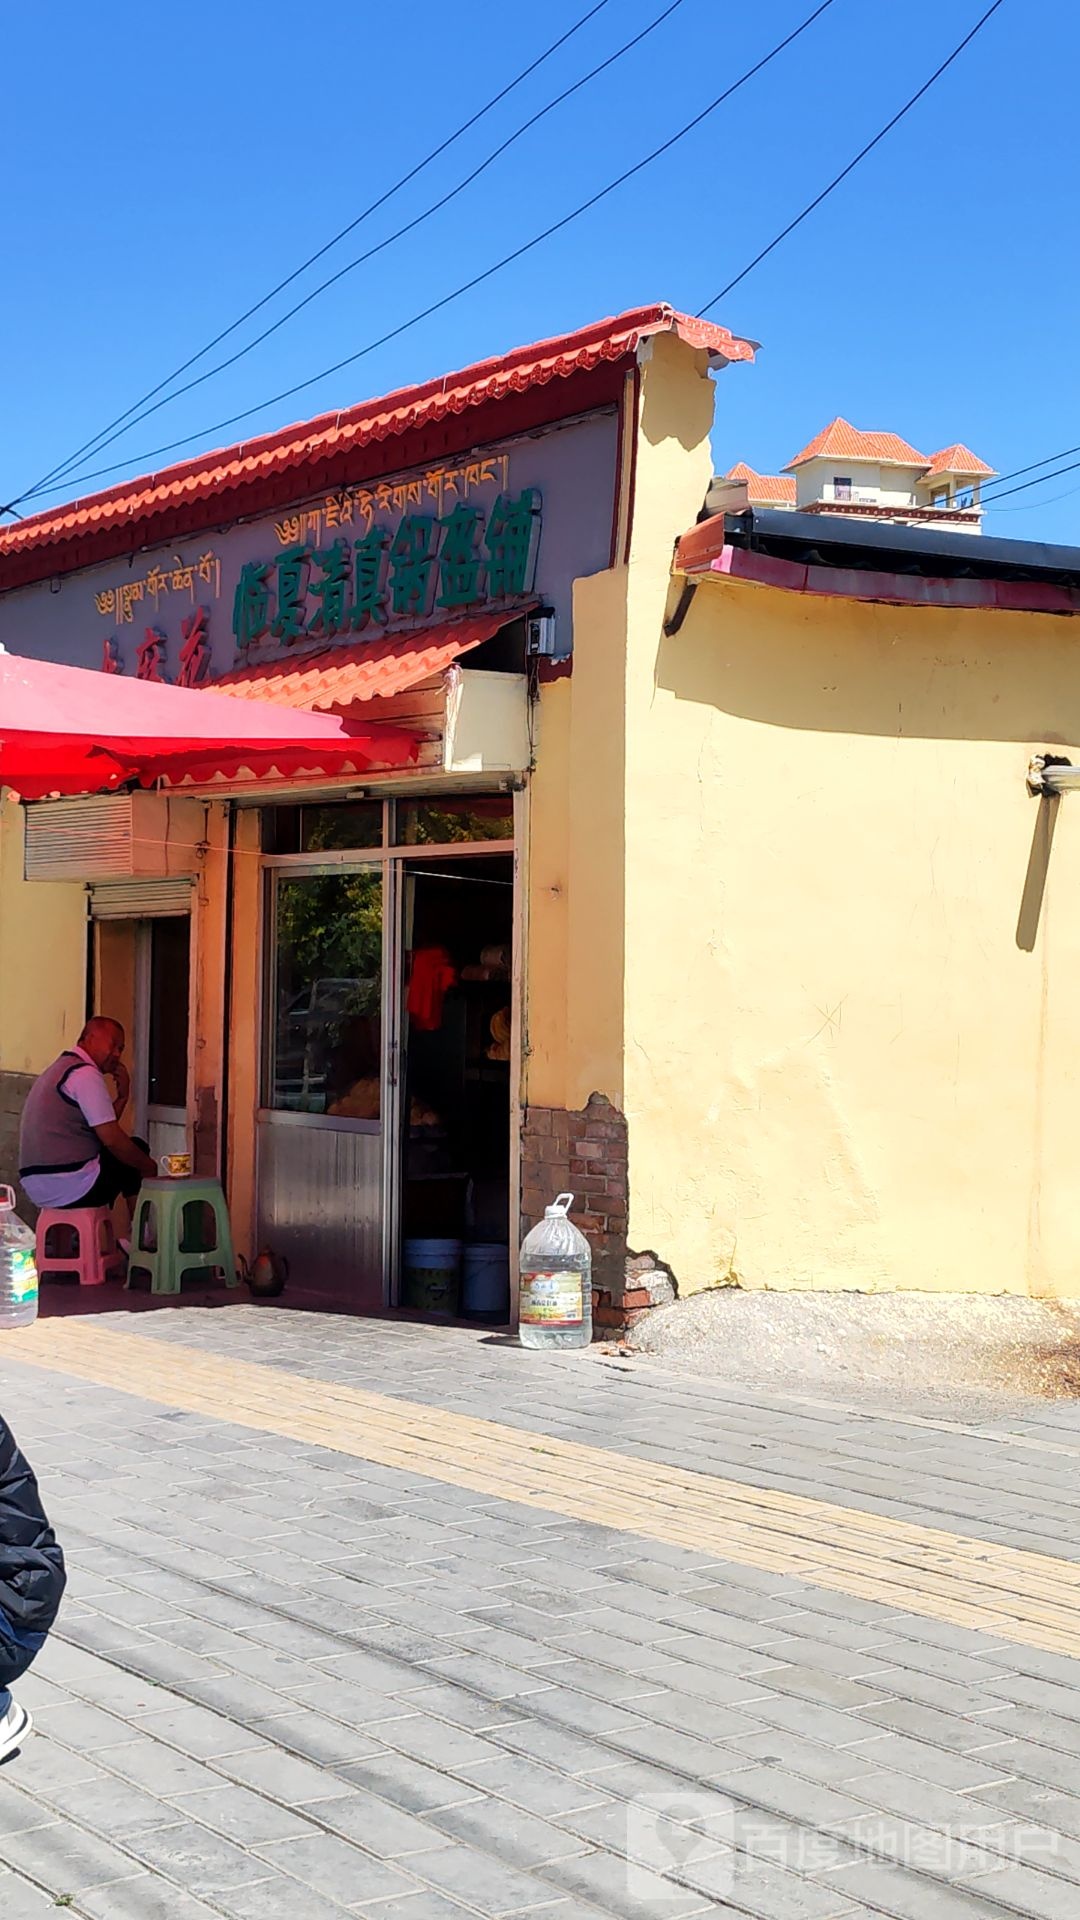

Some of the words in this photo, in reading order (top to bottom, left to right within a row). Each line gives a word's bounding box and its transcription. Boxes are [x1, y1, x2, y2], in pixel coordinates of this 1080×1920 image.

[232, 488, 538, 649] 临夏清真锅盔铺
